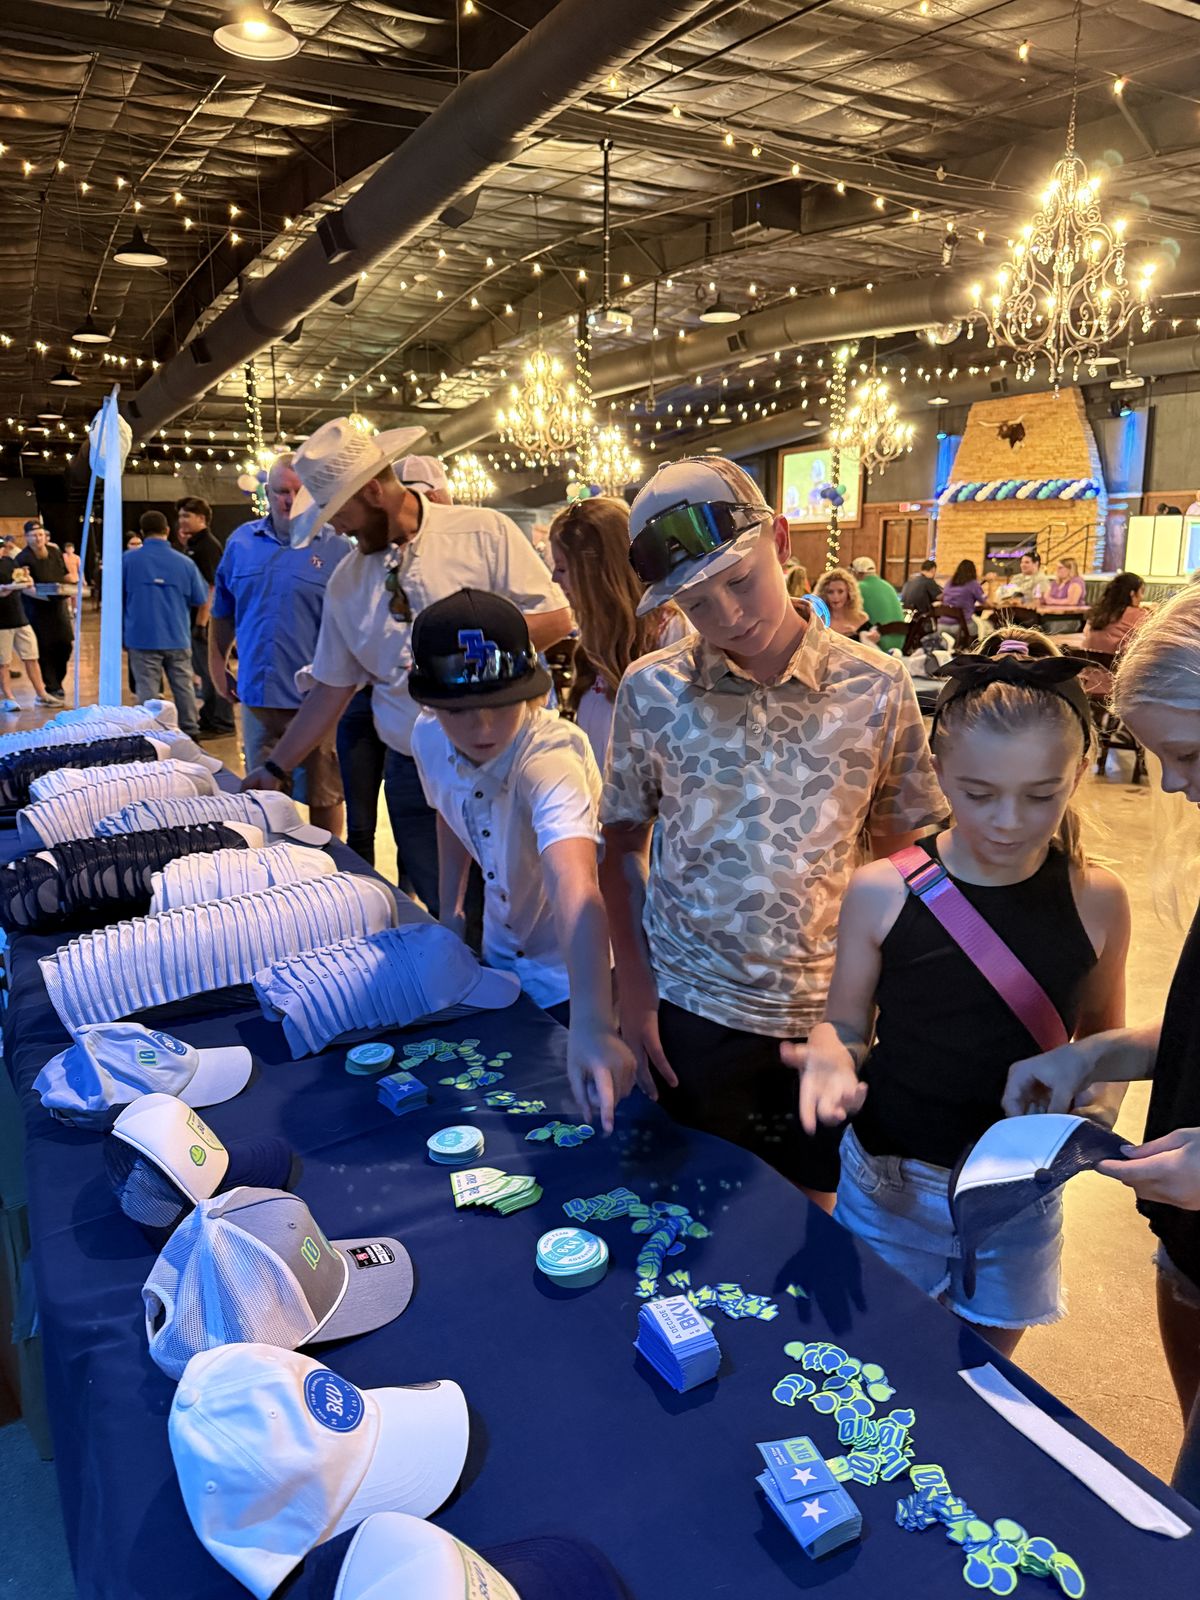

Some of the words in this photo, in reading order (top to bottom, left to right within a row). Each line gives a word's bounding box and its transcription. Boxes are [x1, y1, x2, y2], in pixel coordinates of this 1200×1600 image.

[301, 1236, 320, 1270] 10
[556, 1240, 581, 1253] BKV
[659, 1309, 679, 1334] DECADE
[665, 1301, 700, 1330] BKV
[325, 1382, 344, 1417] BKV
[789, 1443, 814, 1460] BKV
